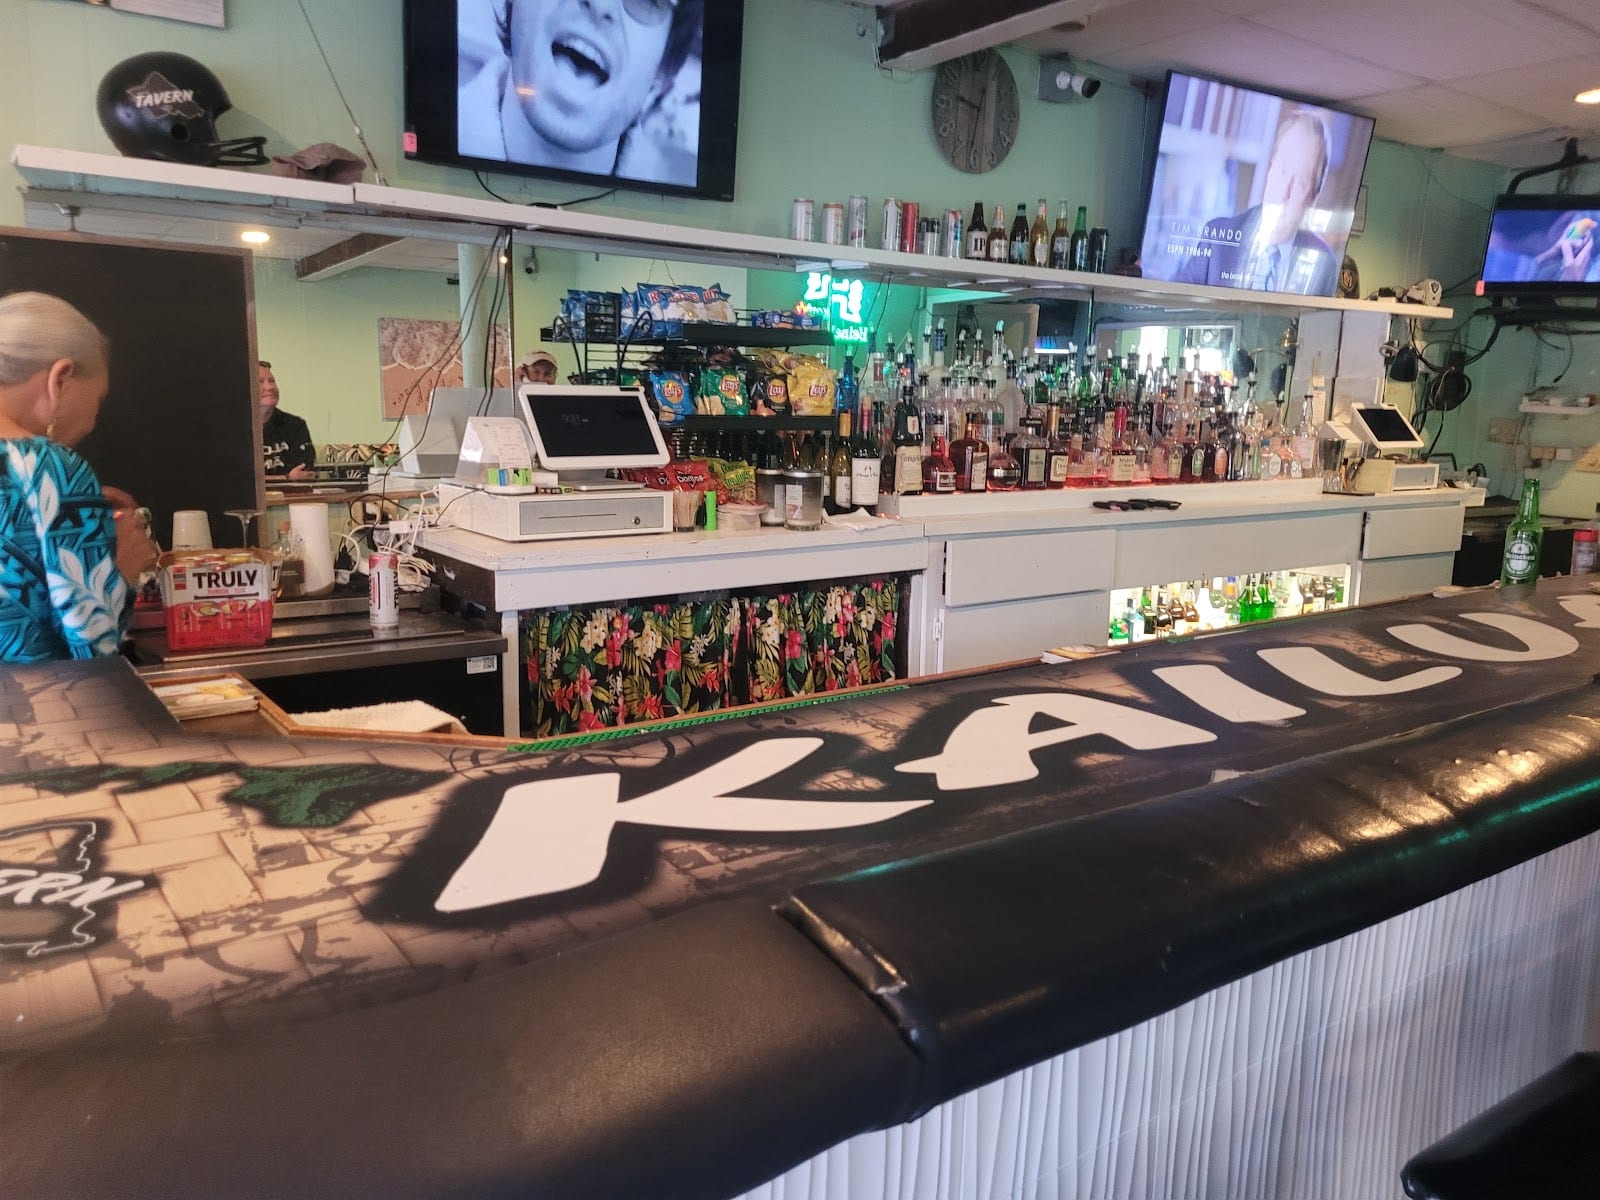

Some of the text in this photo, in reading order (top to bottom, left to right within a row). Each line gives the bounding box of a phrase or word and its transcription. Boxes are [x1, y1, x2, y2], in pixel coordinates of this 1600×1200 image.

[135, 89, 194, 108] TAVERN
[1171, 222, 1190, 233] TIM
[664, 384, 682, 398] Lay's
[722, 380, 739, 393] Lay's
[809, 384, 828, 398] Lay's
[193, 569, 258, 590] TRULY
[434, 594, 1600, 913] KAILU
